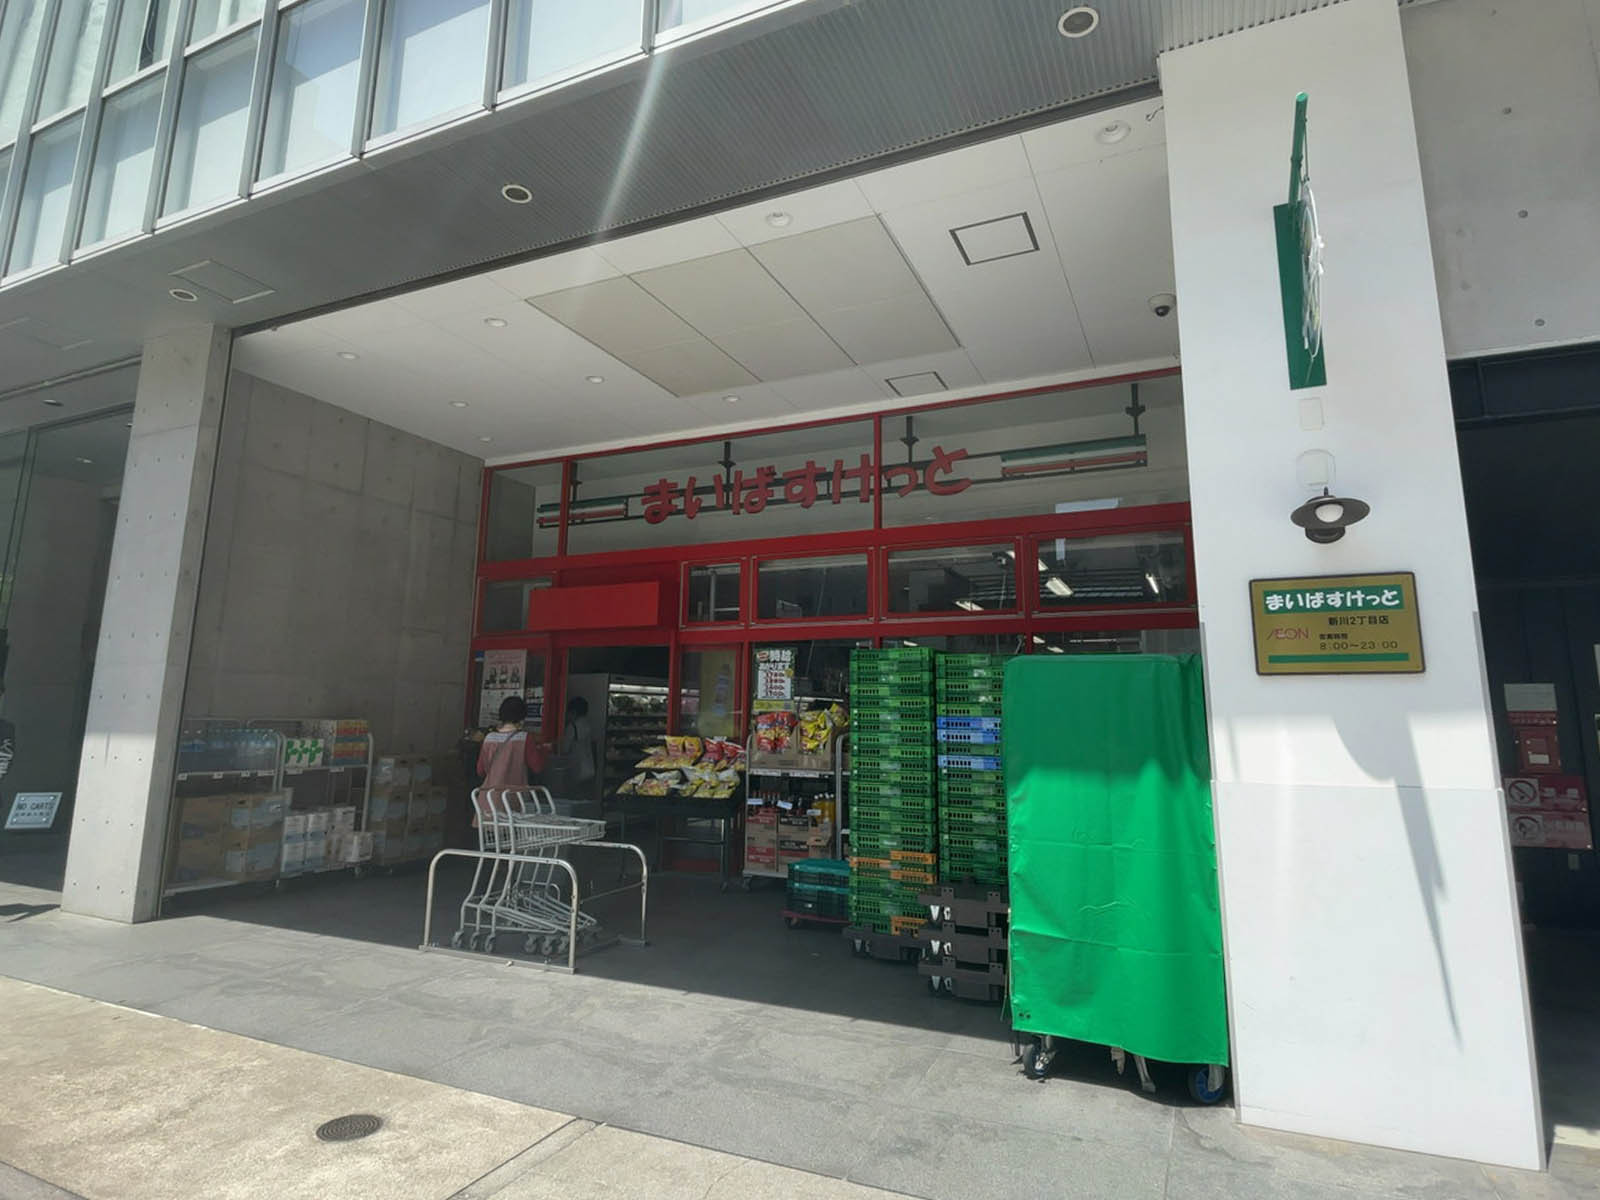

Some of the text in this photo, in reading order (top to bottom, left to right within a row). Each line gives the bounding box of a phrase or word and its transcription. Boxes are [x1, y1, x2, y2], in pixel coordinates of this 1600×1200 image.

[641, 445, 973, 525] まいばすけっと
[1265, 589, 1400, 611] まいばすけっと
